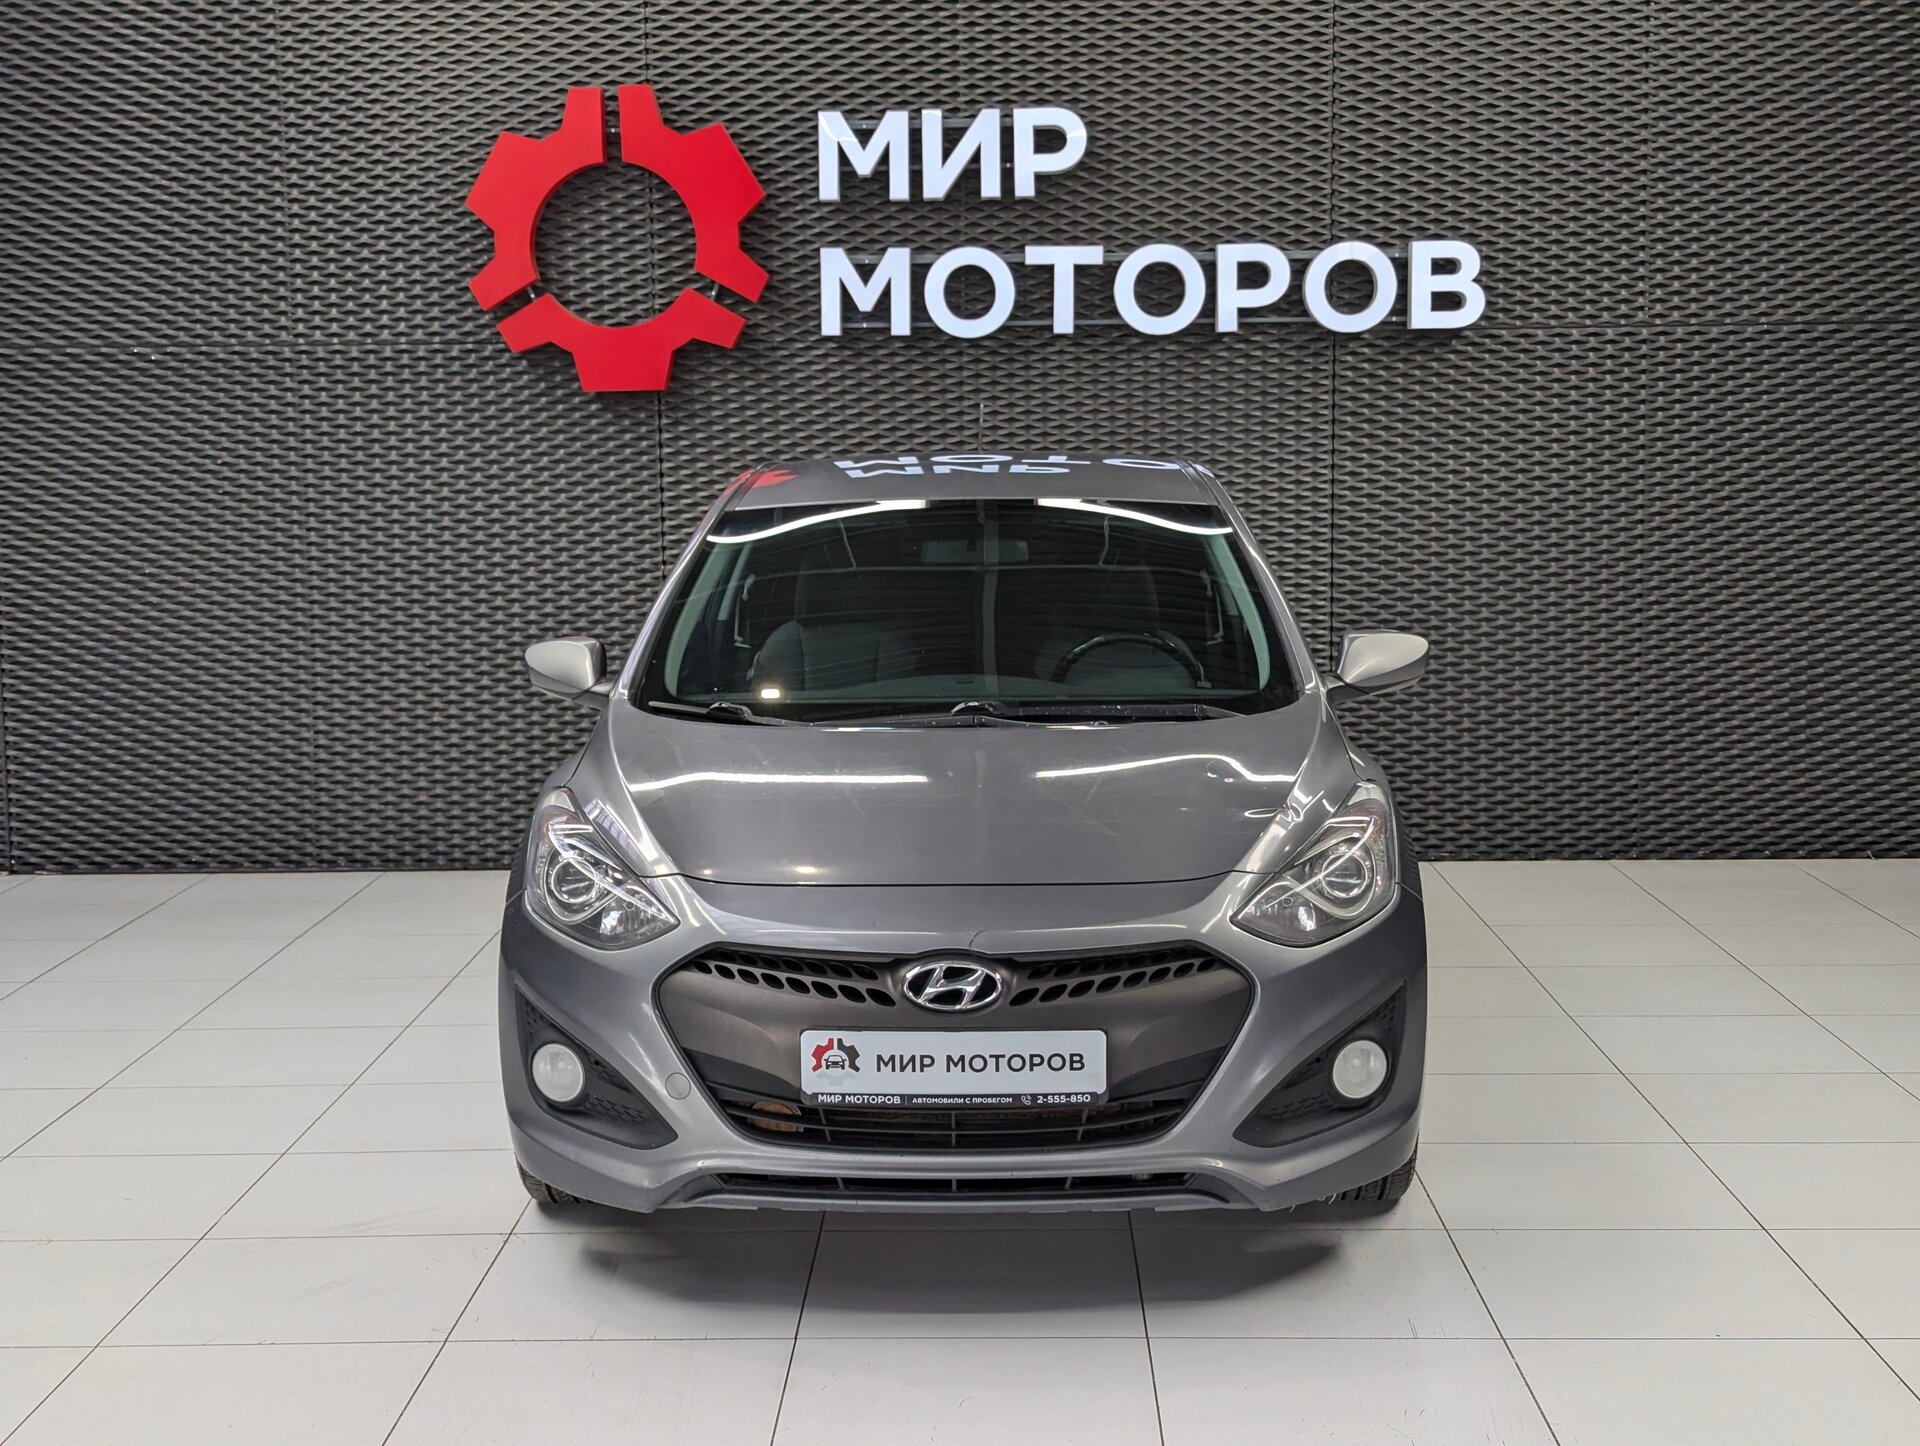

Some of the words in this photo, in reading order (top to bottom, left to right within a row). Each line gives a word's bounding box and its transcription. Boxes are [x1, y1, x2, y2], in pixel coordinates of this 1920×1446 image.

[817, 107, 1087, 202] МИР
[819, 240, 1486, 338] МОТОРОВ
[876, 1054, 935, 1073] МИР
[946, 1053, 1085, 1073] МОТОРОВ
[818, 1094, 842, 1104] МИР
[845, 1095, 901, 1104] МОТОРОВ
[1036, 1094, 1091, 1104] 2-555-850
